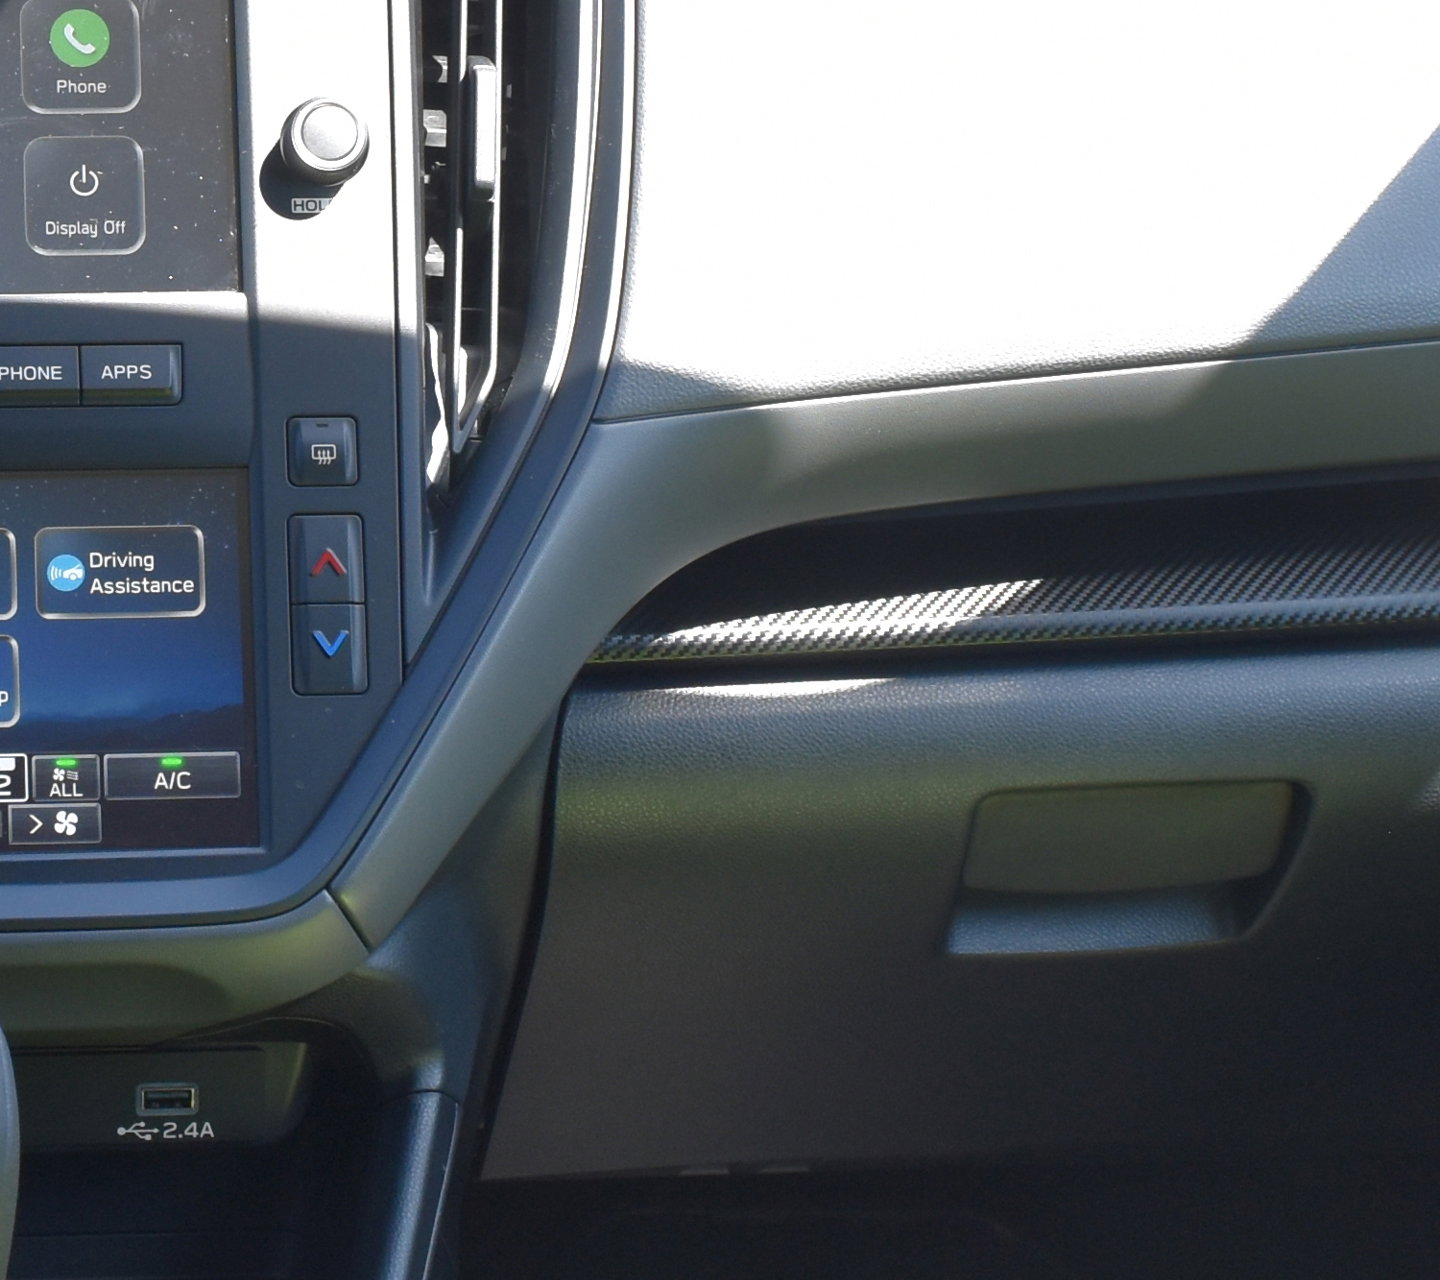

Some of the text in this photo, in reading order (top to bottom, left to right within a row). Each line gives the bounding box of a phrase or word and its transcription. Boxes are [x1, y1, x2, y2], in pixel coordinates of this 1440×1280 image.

[56, 78, 107, 95] Phone
[292, 199, 326, 212] HOL
[45, 220, 126, 238] Display Off
[101, 364, 153, 380] APPS
[88, 552, 155, 572] Driving
[90, 576, 195, 594] Assistance
[49, 781, 84, 798] ALL
[154, 771, 192, 790] A/C
[163, 1121, 215, 1139] 2.4A
